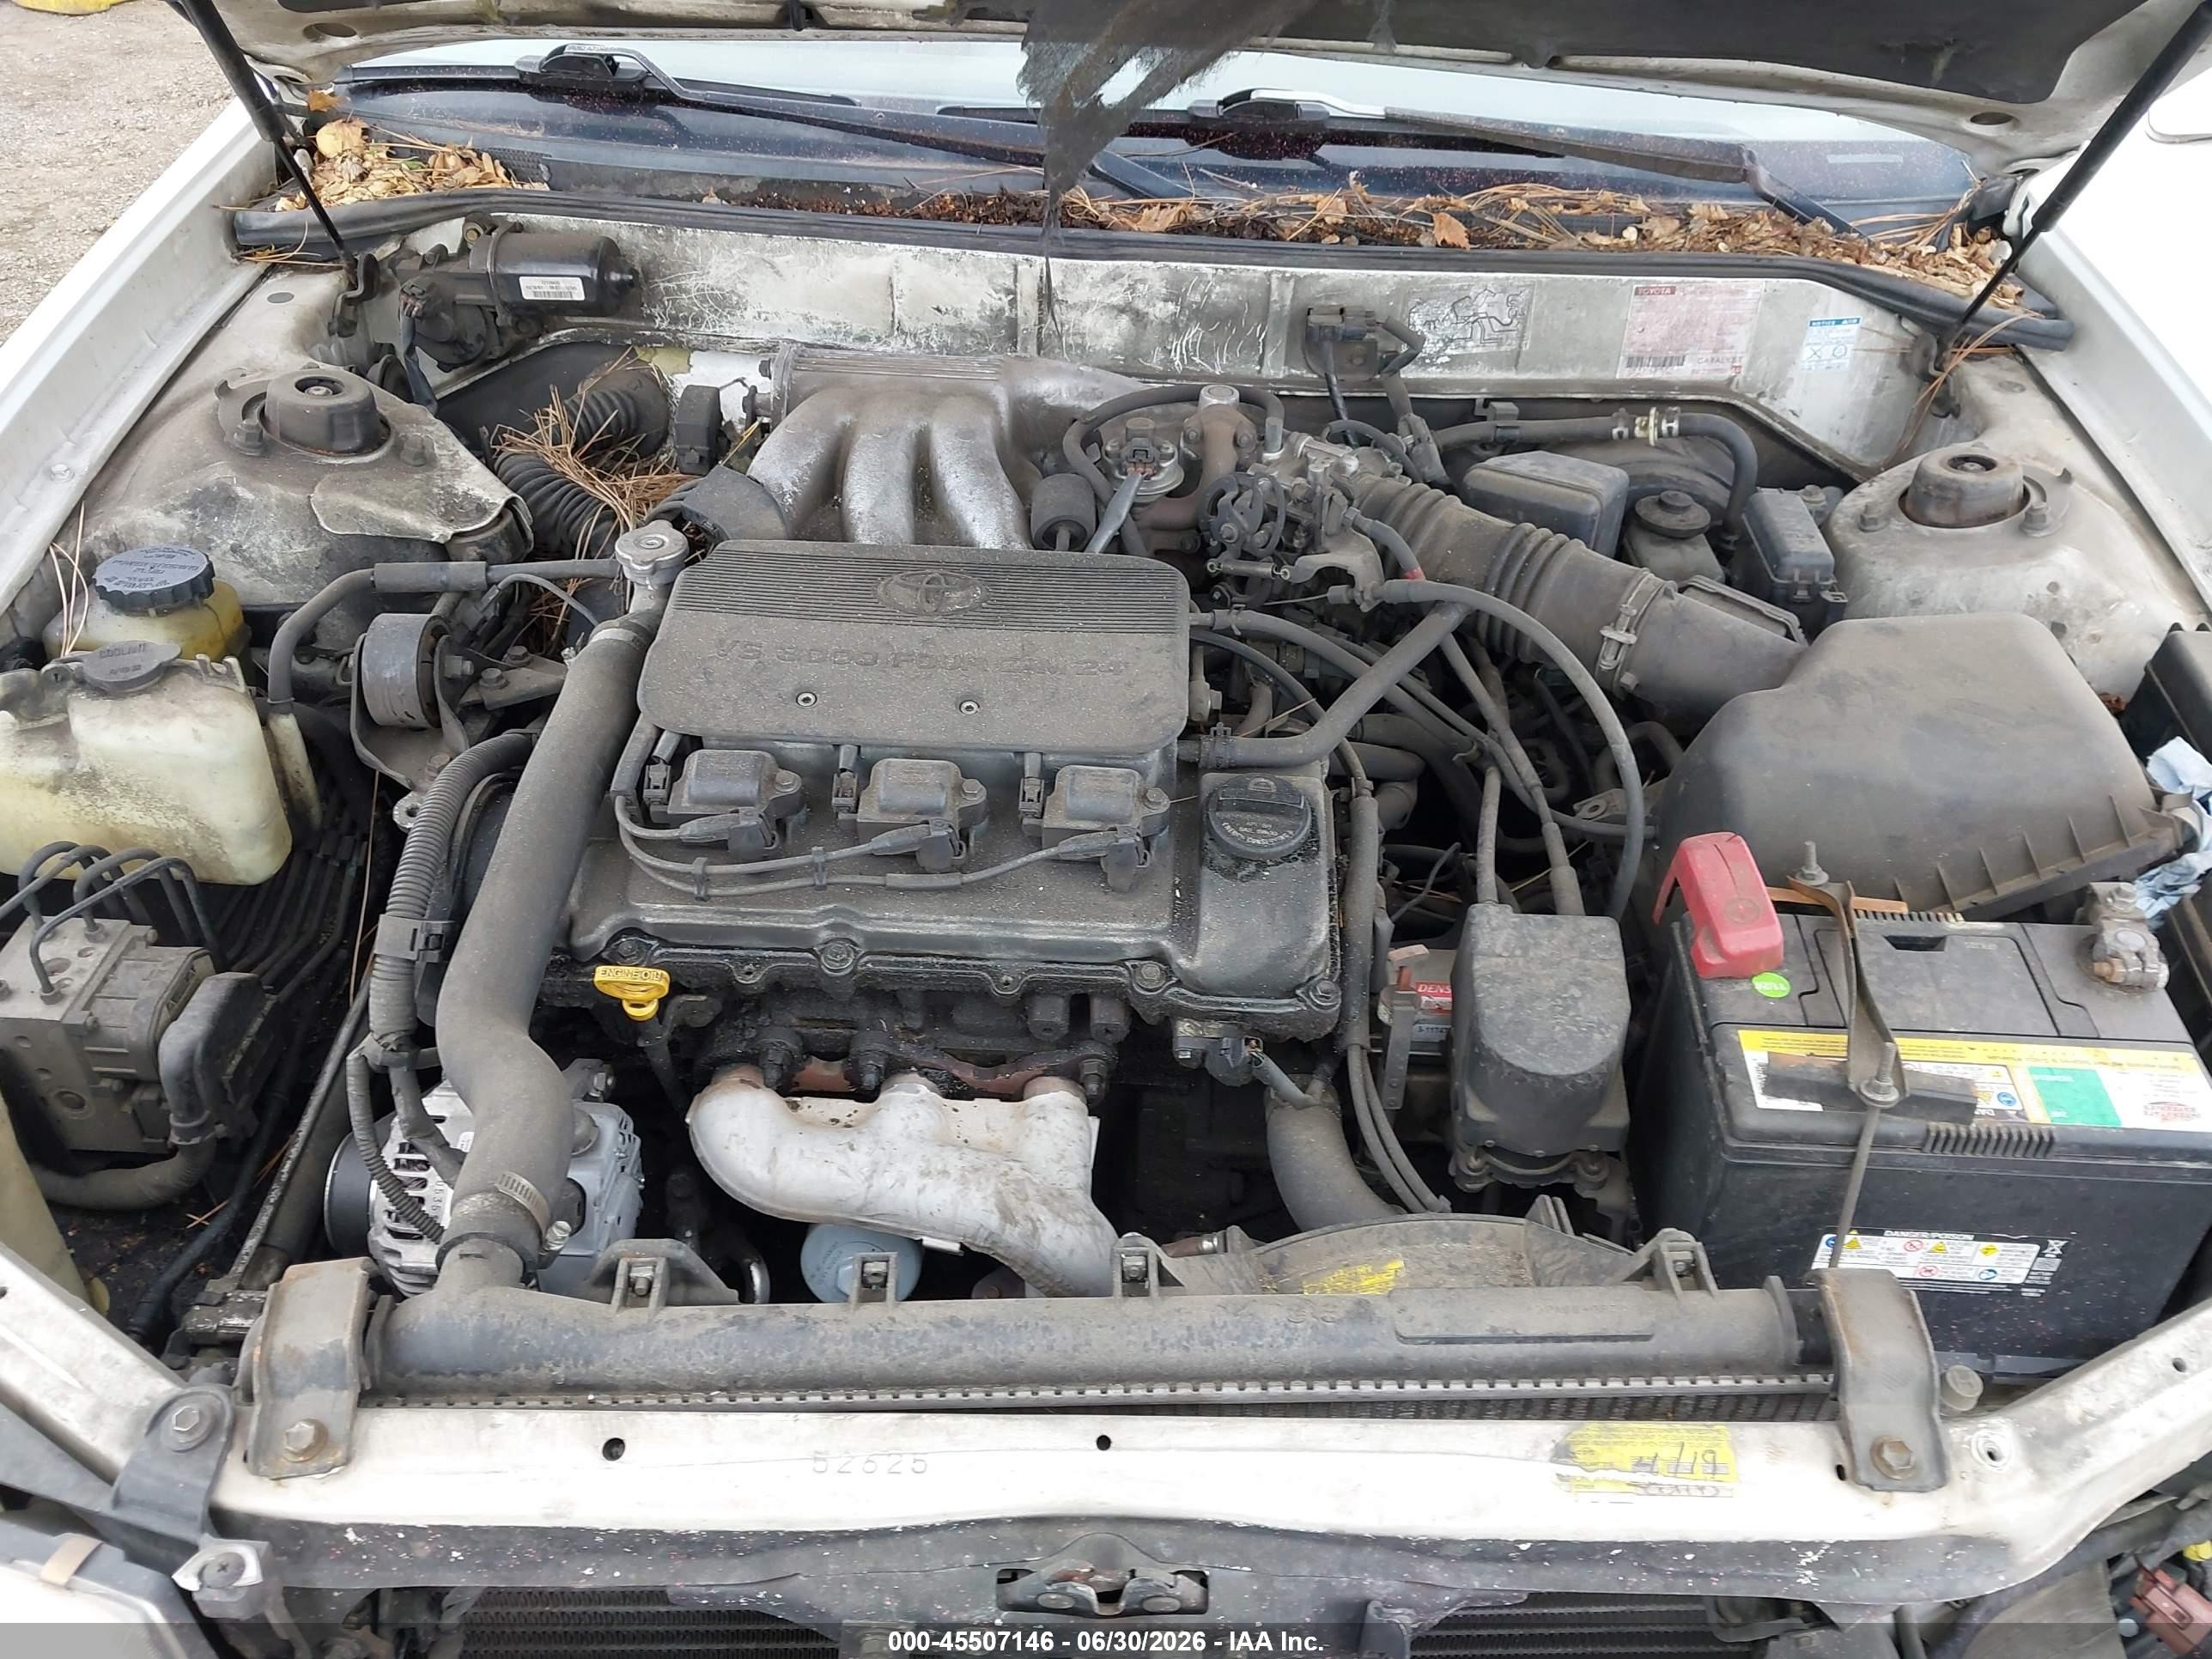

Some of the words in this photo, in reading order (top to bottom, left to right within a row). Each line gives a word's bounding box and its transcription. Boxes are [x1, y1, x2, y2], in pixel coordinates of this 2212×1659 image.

[600, 968, 640, 978] ENGINE
[641, 970, 662, 981] OIL
[1418, 984, 1452, 994] DENS
